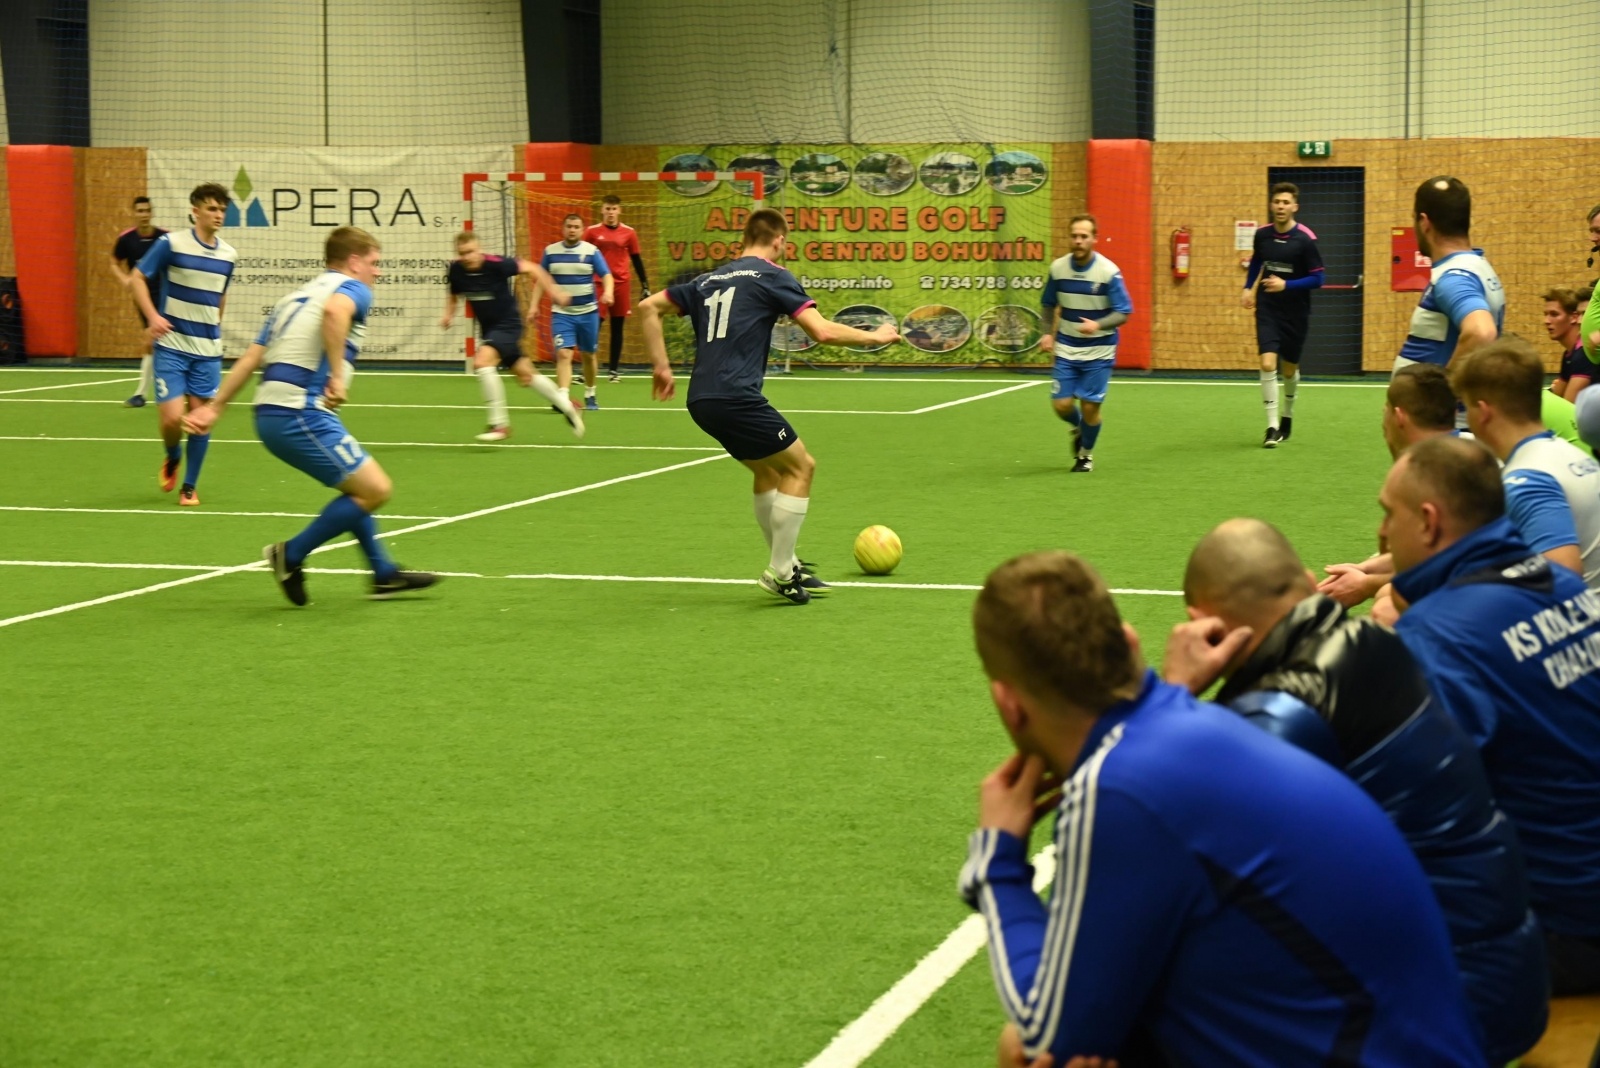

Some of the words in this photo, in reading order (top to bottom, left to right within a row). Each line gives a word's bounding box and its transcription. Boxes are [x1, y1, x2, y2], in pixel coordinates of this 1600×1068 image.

[706, 206, 908, 231] ADENTURE
[918, 206, 1005, 231] GOLF
[667, 241, 687, 261] V
[692, 241, 799, 261] BOSR
[804, 241, 906, 261] CENTRU
[913, 236, 1045, 261] BOHUMÍN
[940, 275, 971, 289] 734
[975, 275, 1007, 289] 788
[1010, 275, 1043, 289] 666
[704, 286, 736, 343] 11
[333, 434, 364, 466] 17
[1501, 621, 1543, 662] KS
